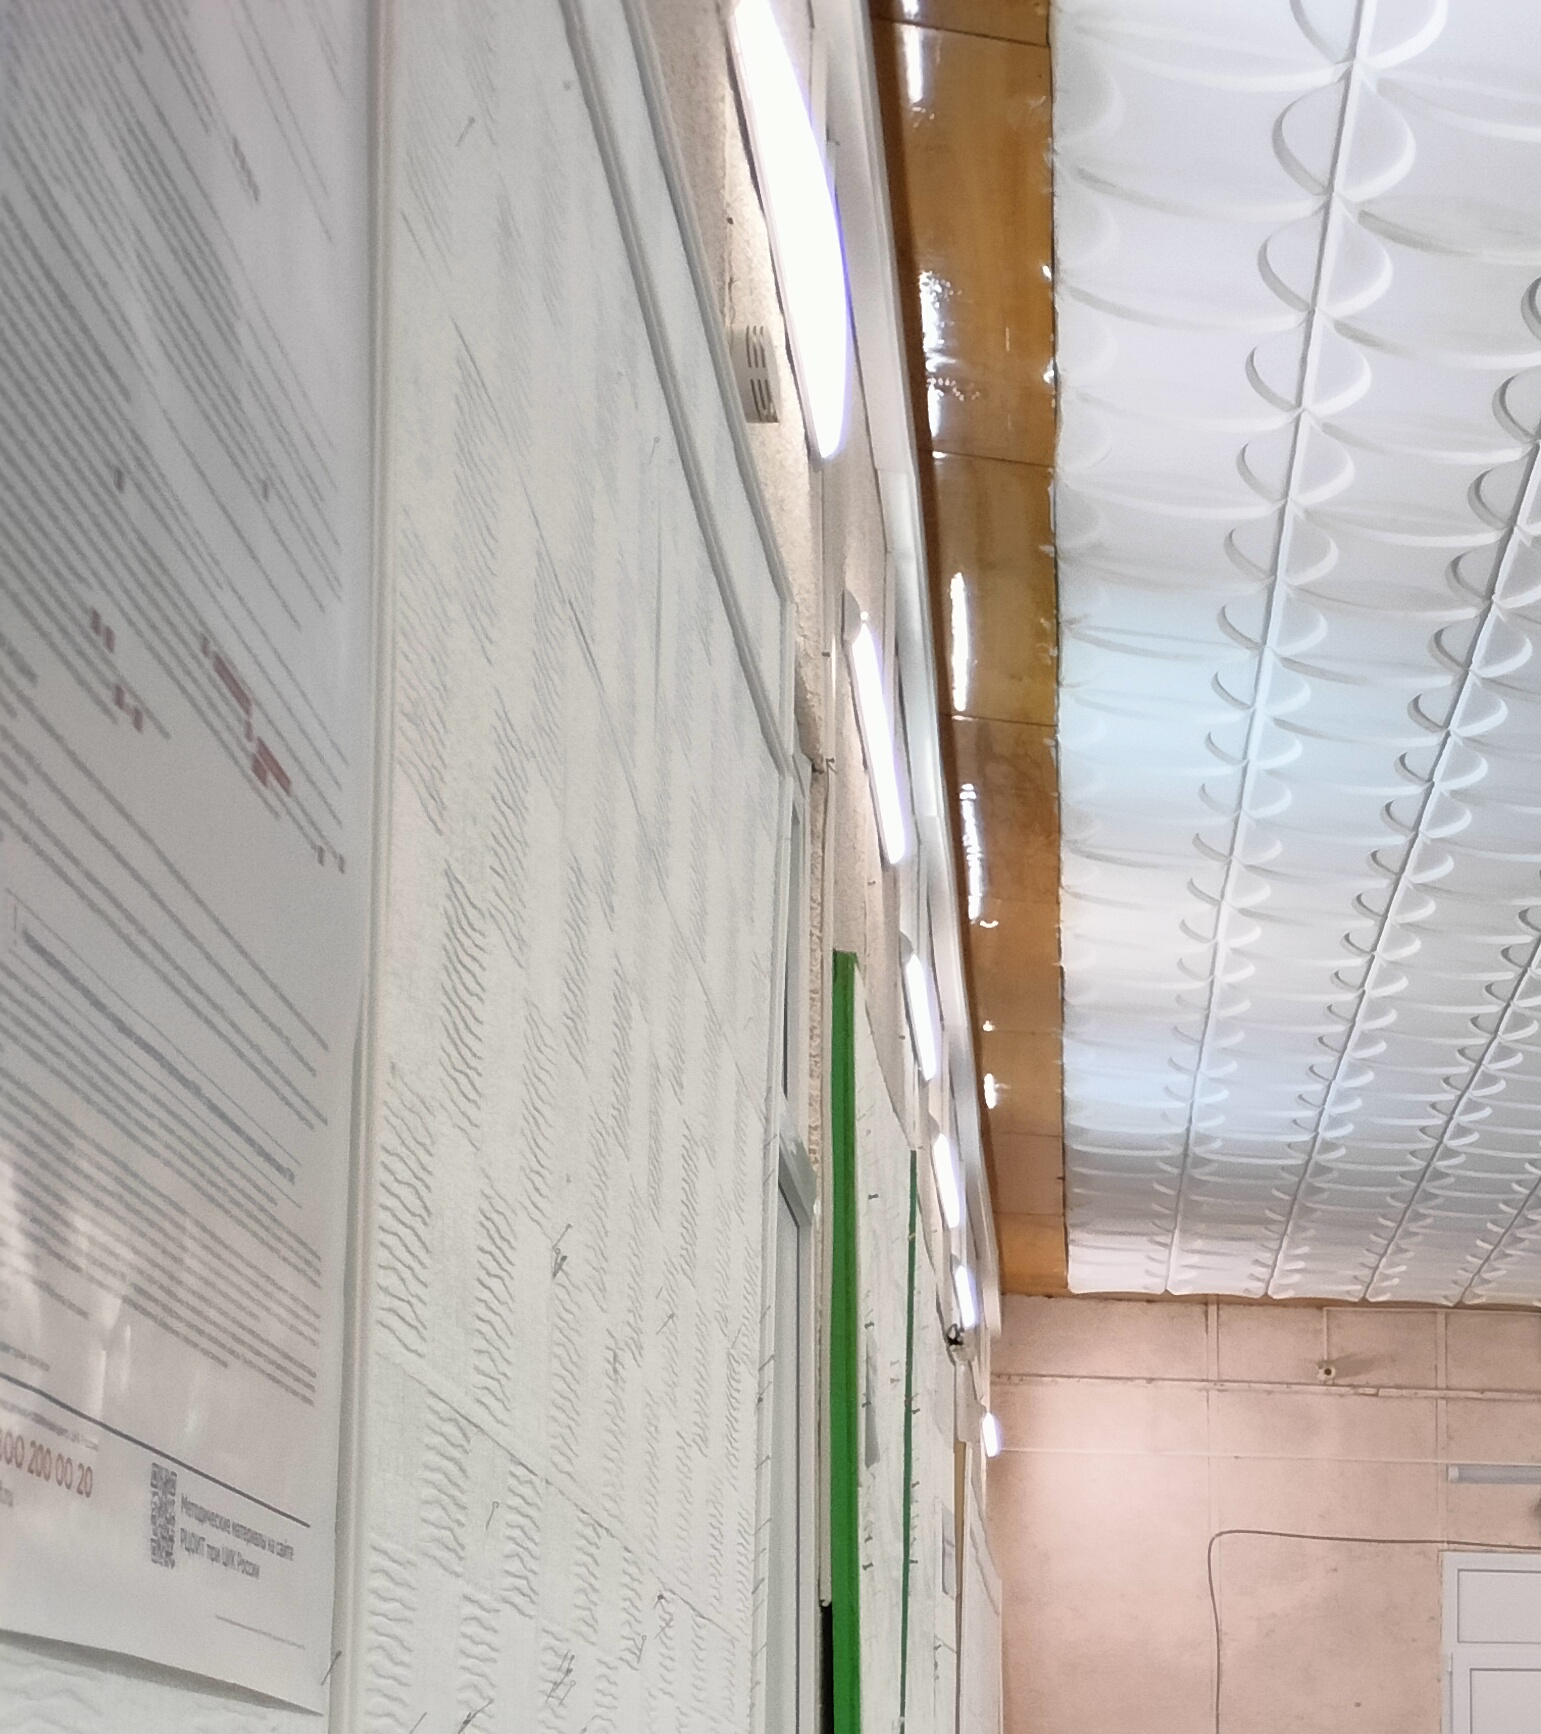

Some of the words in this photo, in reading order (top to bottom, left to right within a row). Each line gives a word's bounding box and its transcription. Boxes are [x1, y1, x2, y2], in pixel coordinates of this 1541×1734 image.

[0, 1428, 24, 1469] 00
[27, 1440, 52, 1482] 200
[55, 1452, 73, 1490] 00
[76, 1462, 93, 1498] 20
